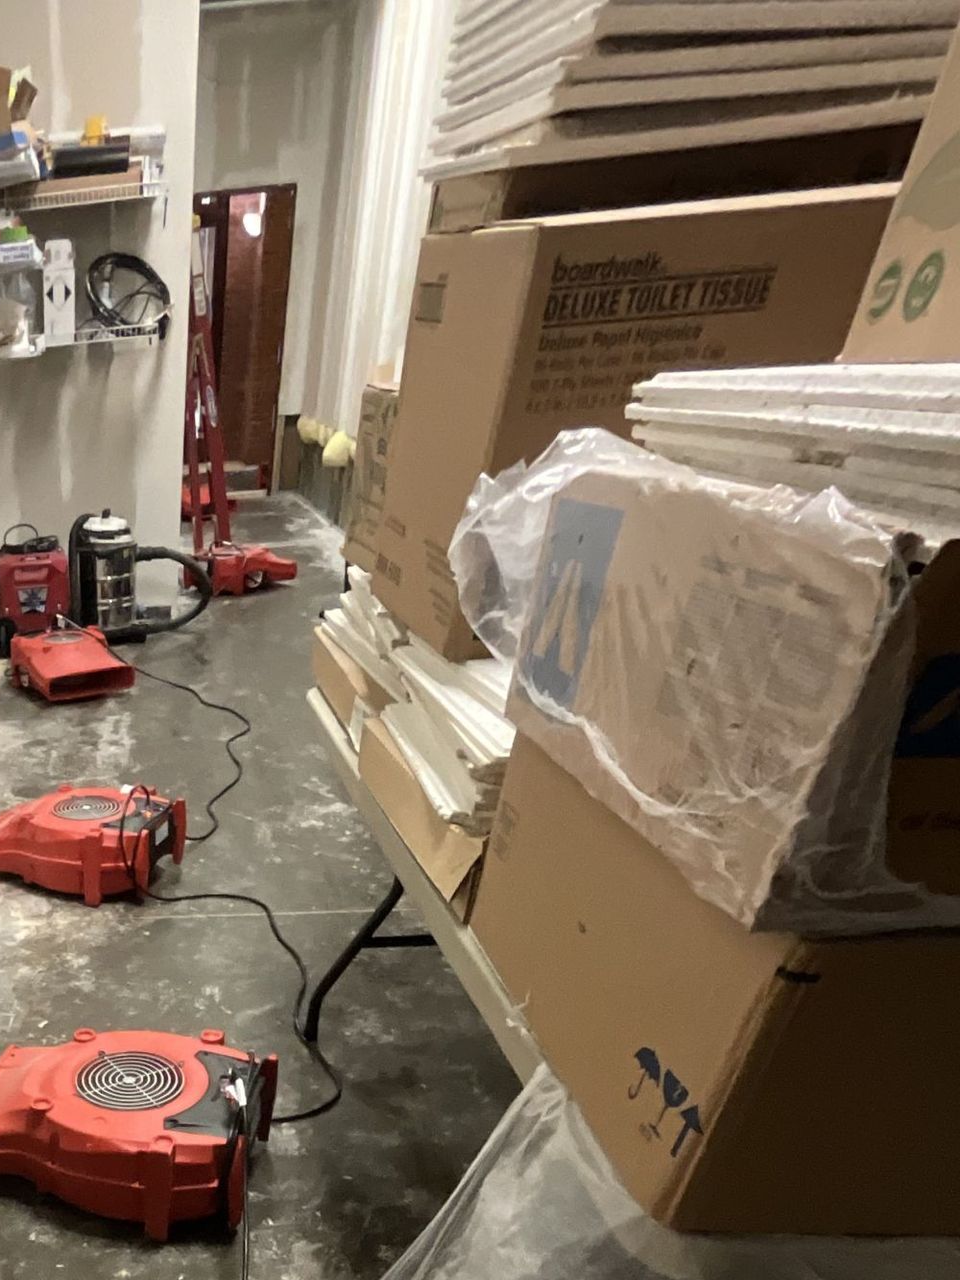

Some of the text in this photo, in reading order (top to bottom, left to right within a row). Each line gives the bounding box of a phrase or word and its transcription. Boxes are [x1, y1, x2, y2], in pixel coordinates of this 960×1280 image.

[551, 253, 661, 284] boardwalk
[543, 273, 776, 323] DELUXE TOILET TISSUE
